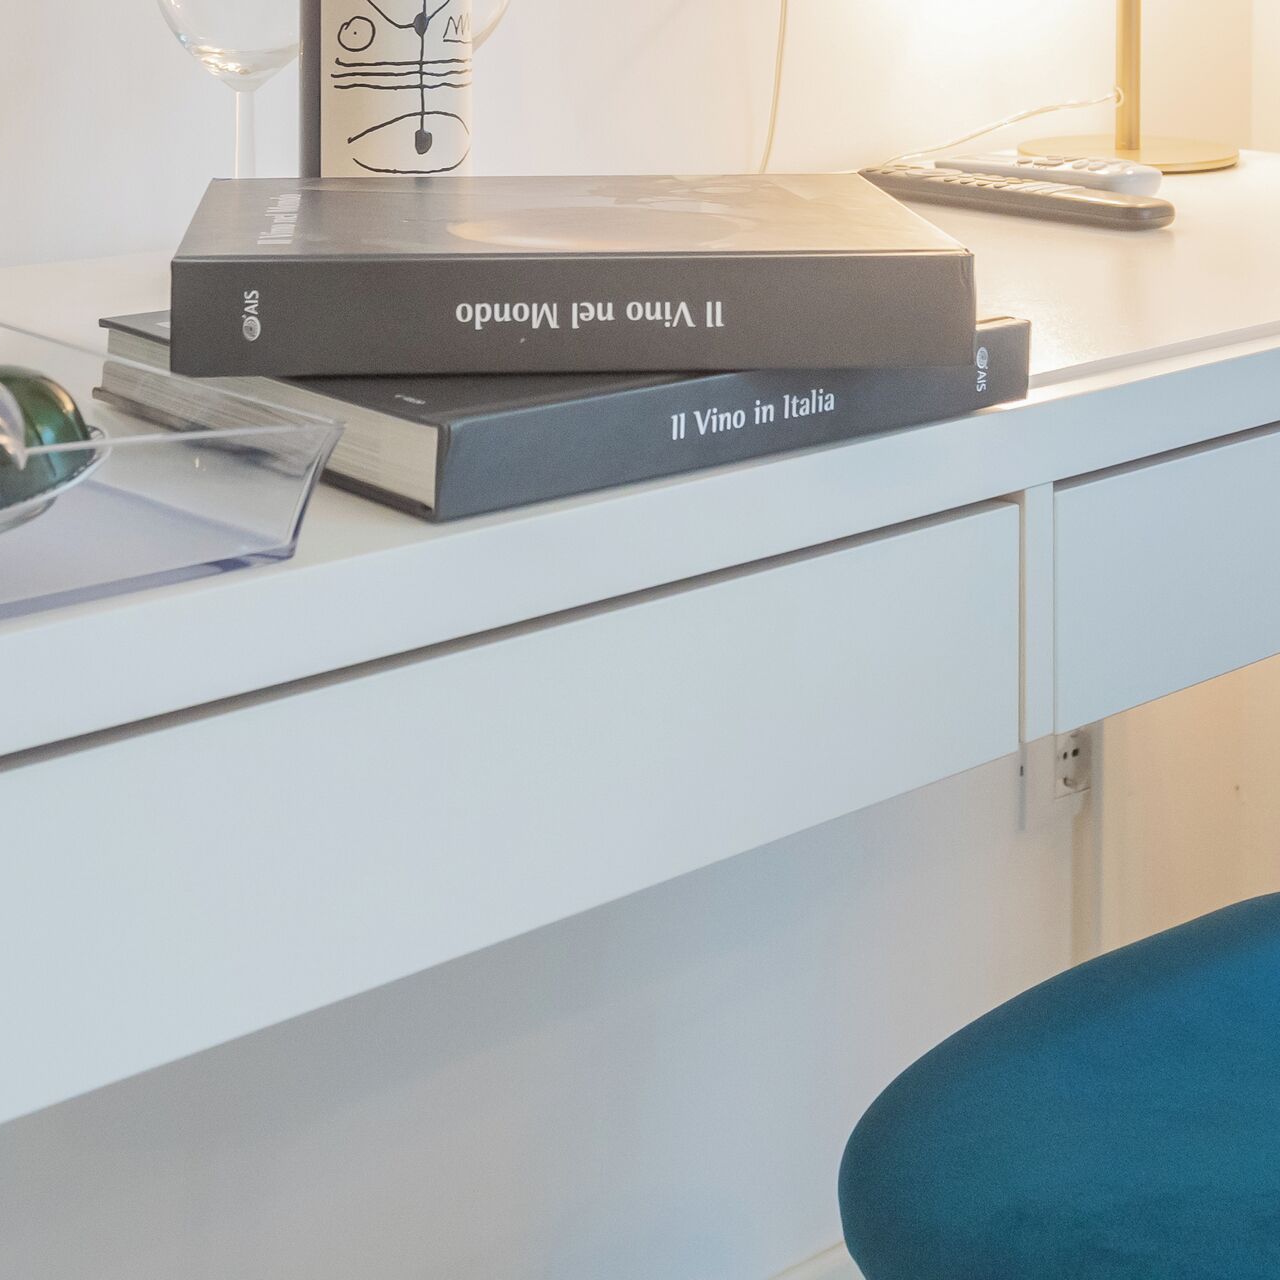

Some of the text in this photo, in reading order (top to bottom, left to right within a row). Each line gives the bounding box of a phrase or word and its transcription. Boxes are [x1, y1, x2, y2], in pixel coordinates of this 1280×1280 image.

[243, 289, 260, 316] AIS
[455, 301, 725, 331] Il Vino nel Mondo
[976, 370, 988, 393] AIS
[670, 388, 836, 441] Il Vino in Italia
